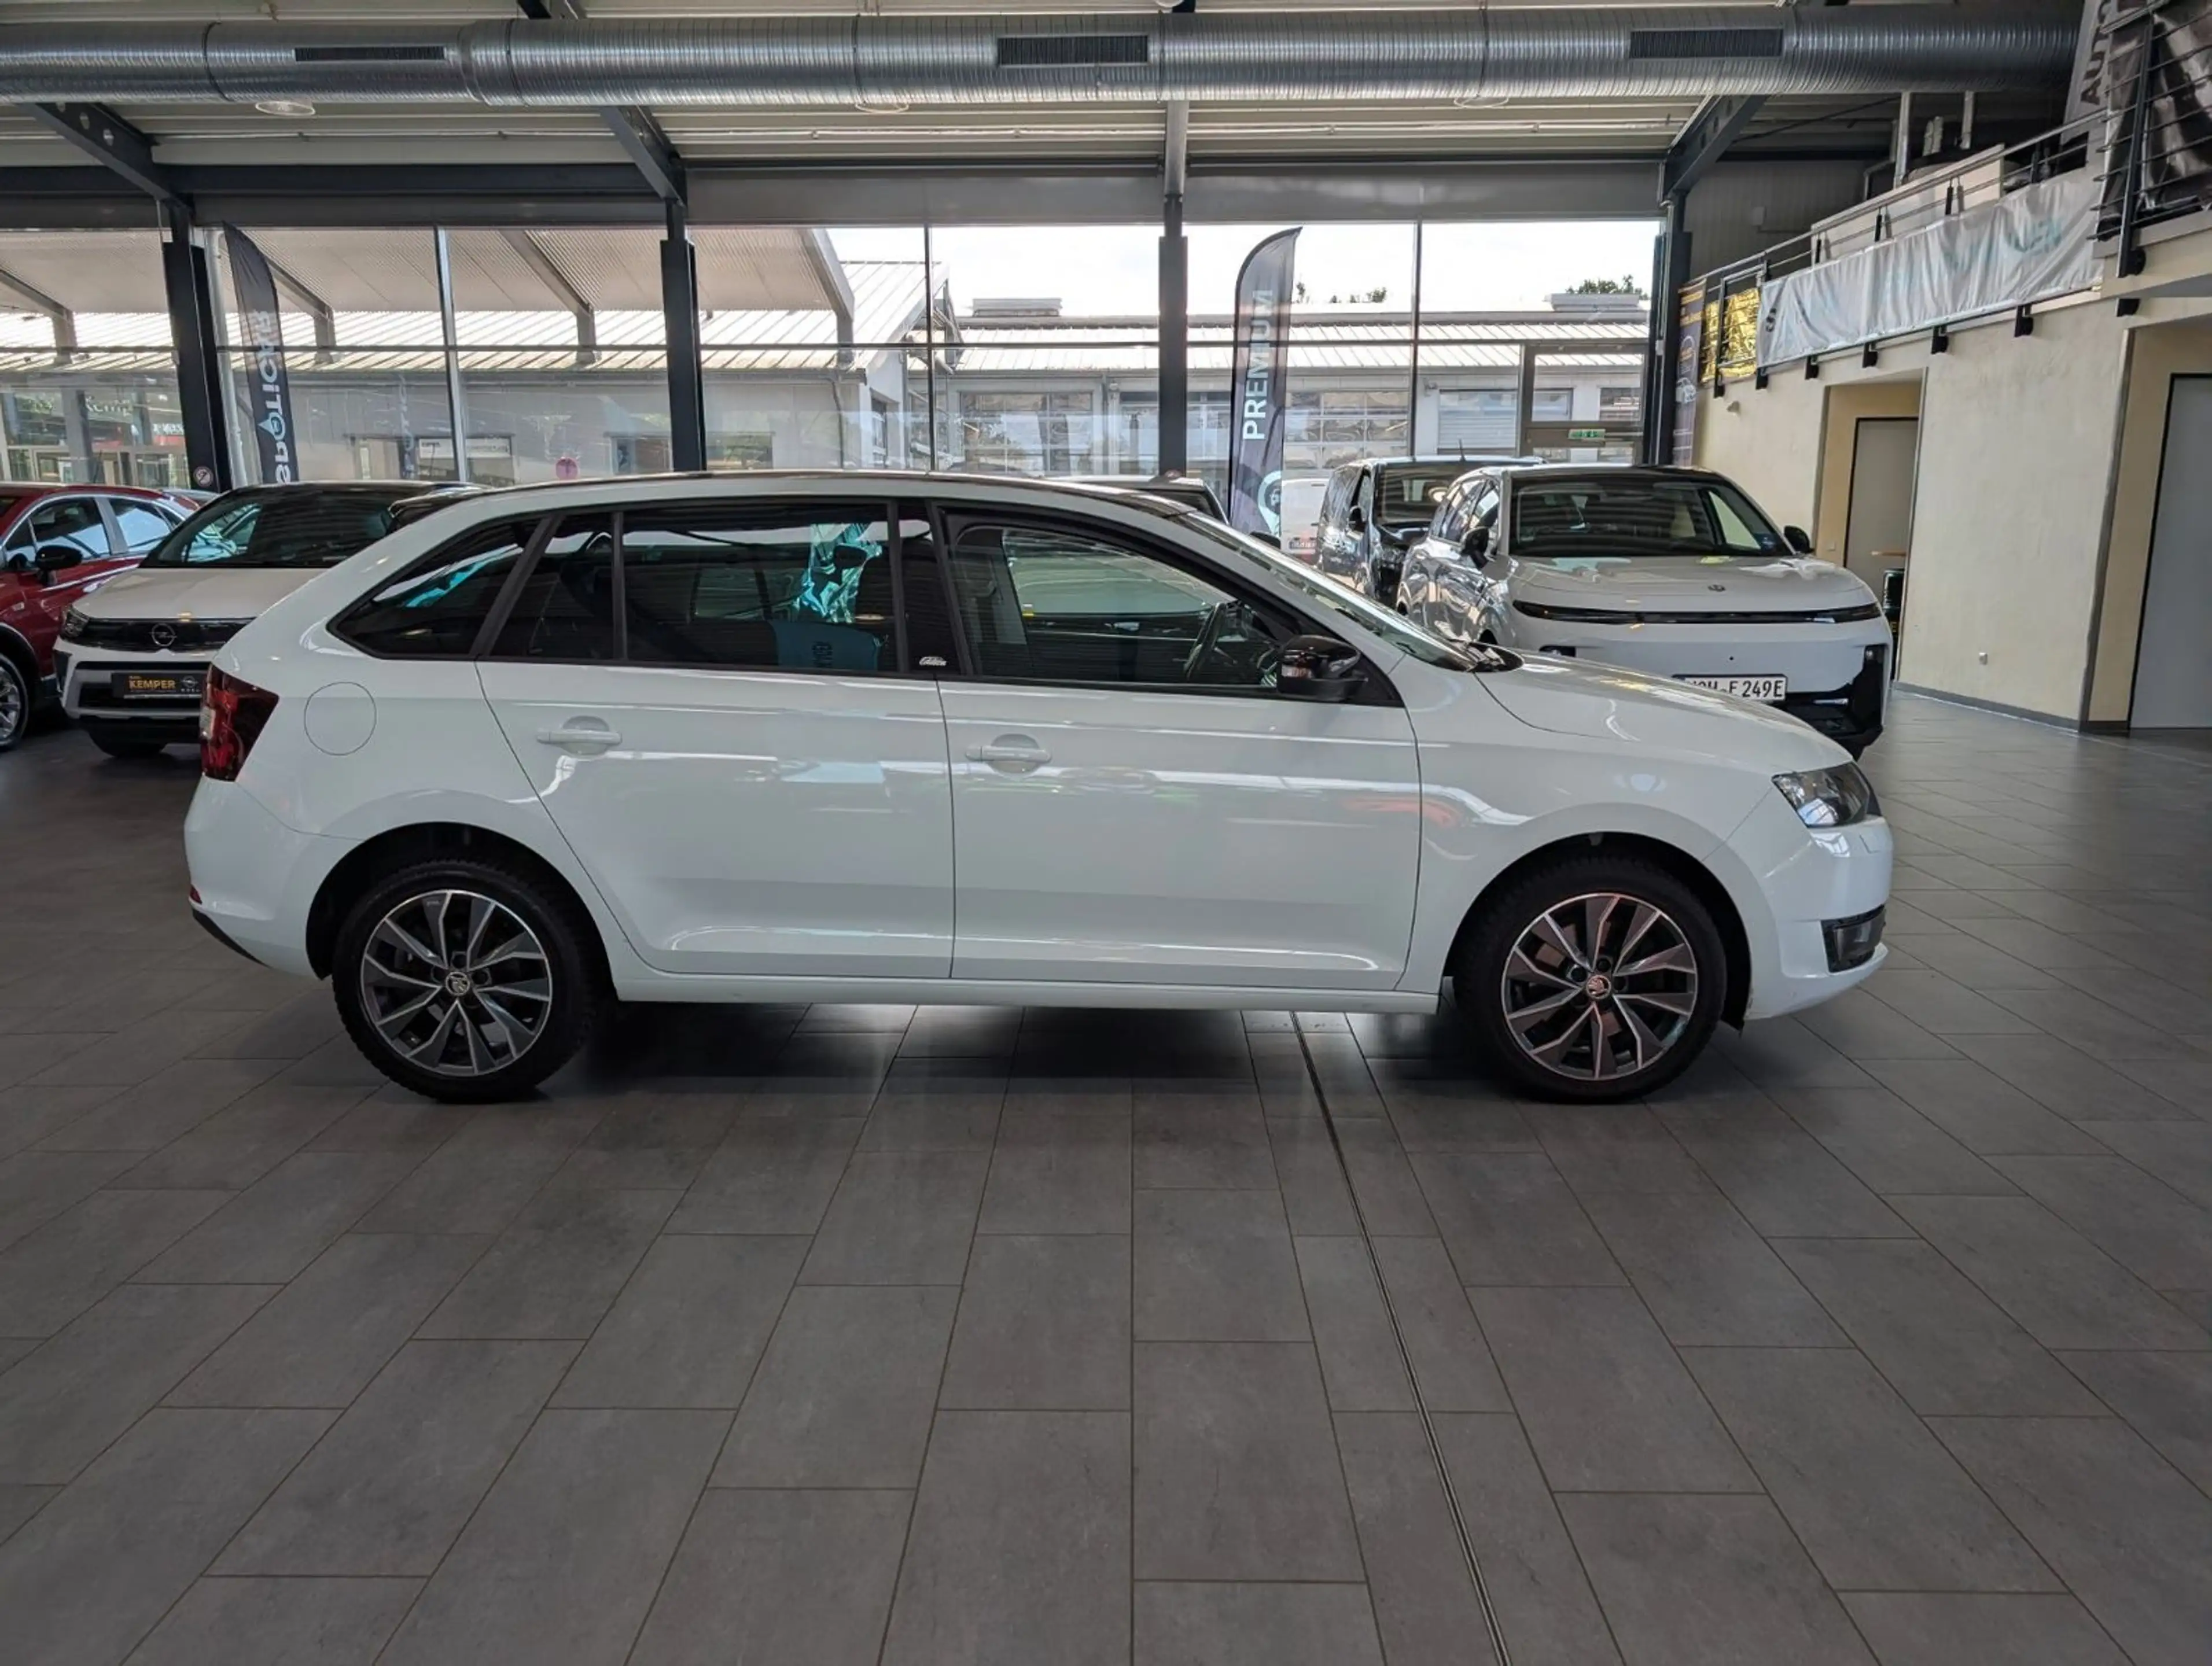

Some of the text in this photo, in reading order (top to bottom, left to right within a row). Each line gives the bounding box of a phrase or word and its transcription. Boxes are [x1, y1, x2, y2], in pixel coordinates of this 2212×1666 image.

[1242, 290, 1273, 440] PREMIUM
[129, 680, 176, 690] KEMPER
[1742, 680, 1784, 698] 249E
